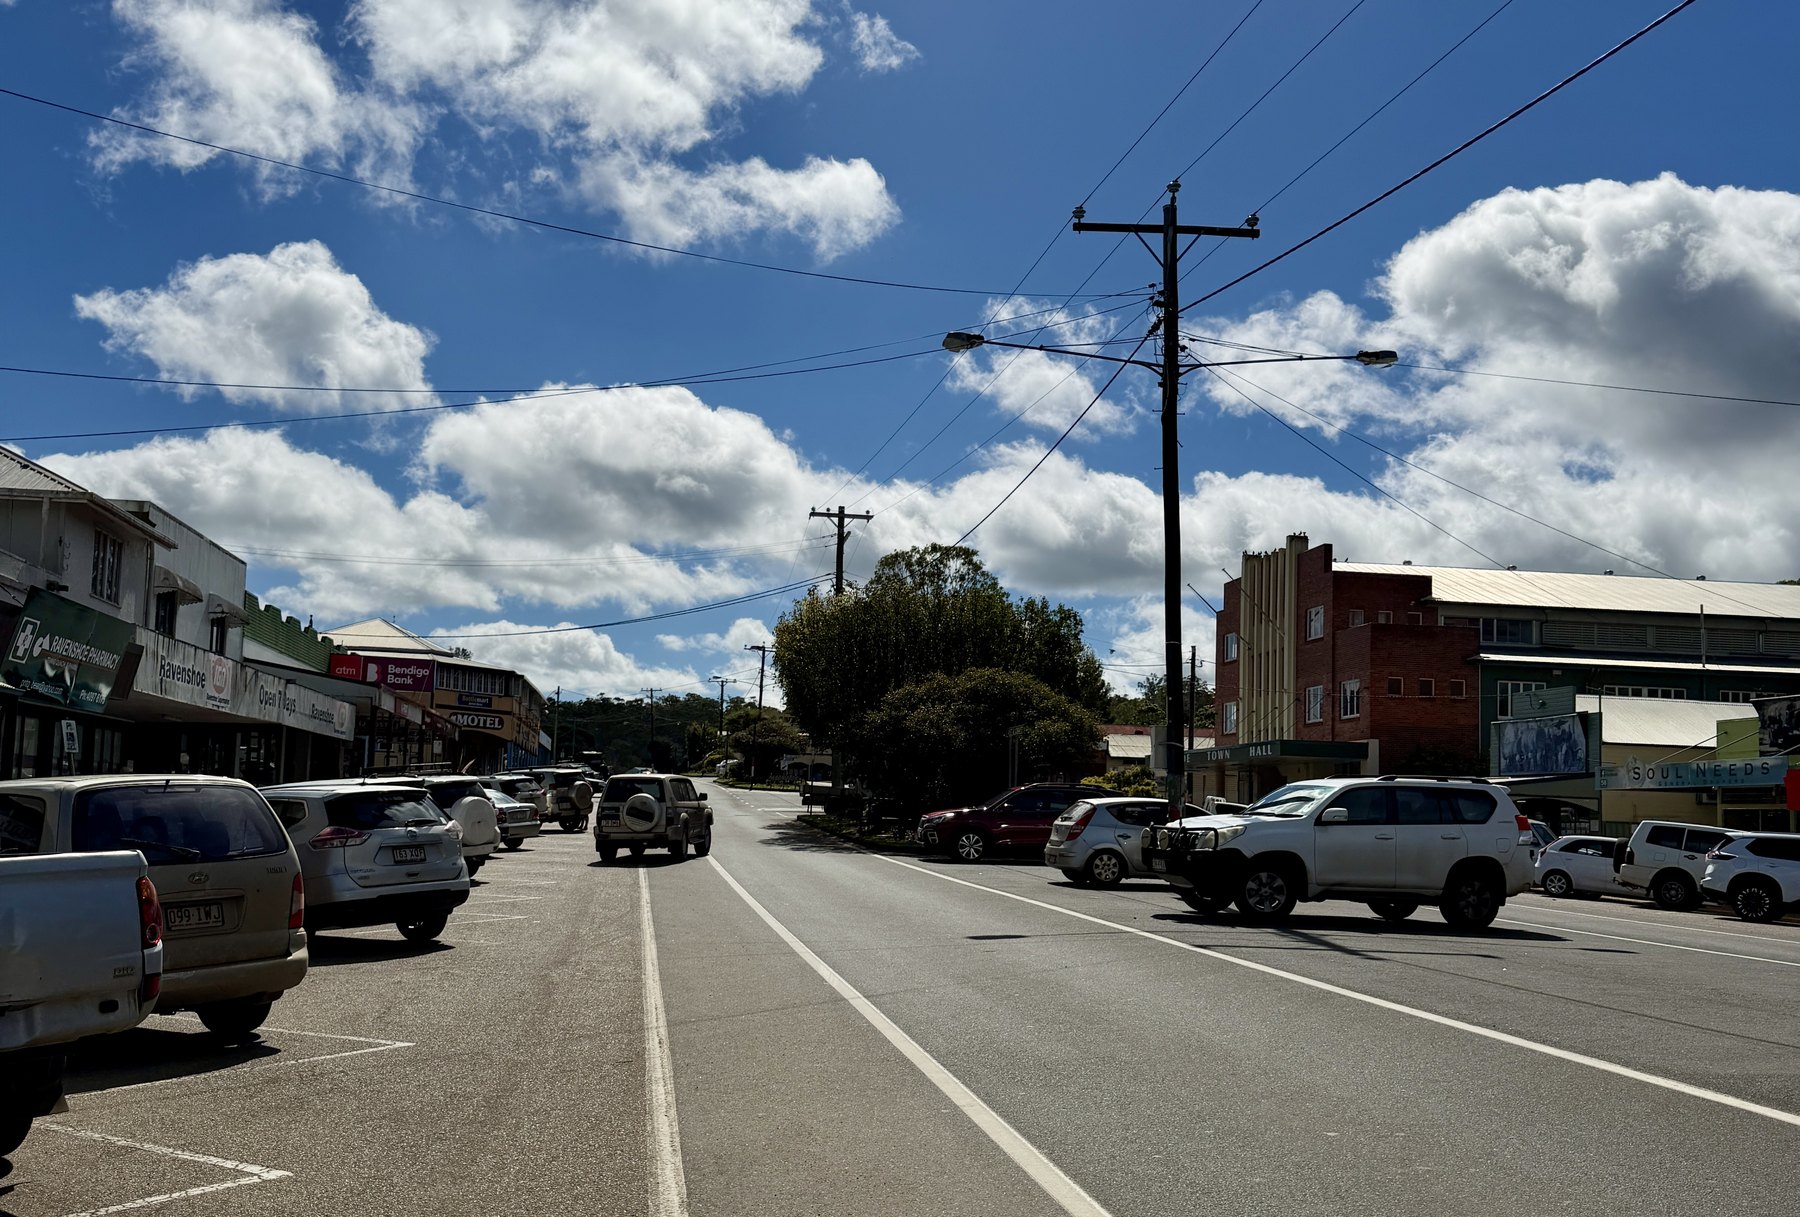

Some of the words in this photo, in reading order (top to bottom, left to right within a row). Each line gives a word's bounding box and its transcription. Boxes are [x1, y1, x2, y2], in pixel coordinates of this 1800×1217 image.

[50, 636, 89, 661] RAVENSHOE
[87, 645, 121, 670] PHARMACY
[159, 654, 206, 689] Ravenshoe
[335, 666, 356, 675] atm
[388, 664, 430, 678] Bendigo
[387, 674, 413, 685] Bank
[259, 684, 276, 711] Open
[455, 714, 502, 728] MOTEL
[1207, 749, 1231, 761] TOWN
[1249, 744, 1272, 757] HALL
[1632, 765, 1683, 780] SOUL
[1696, 762, 1771, 778] NEEDS
